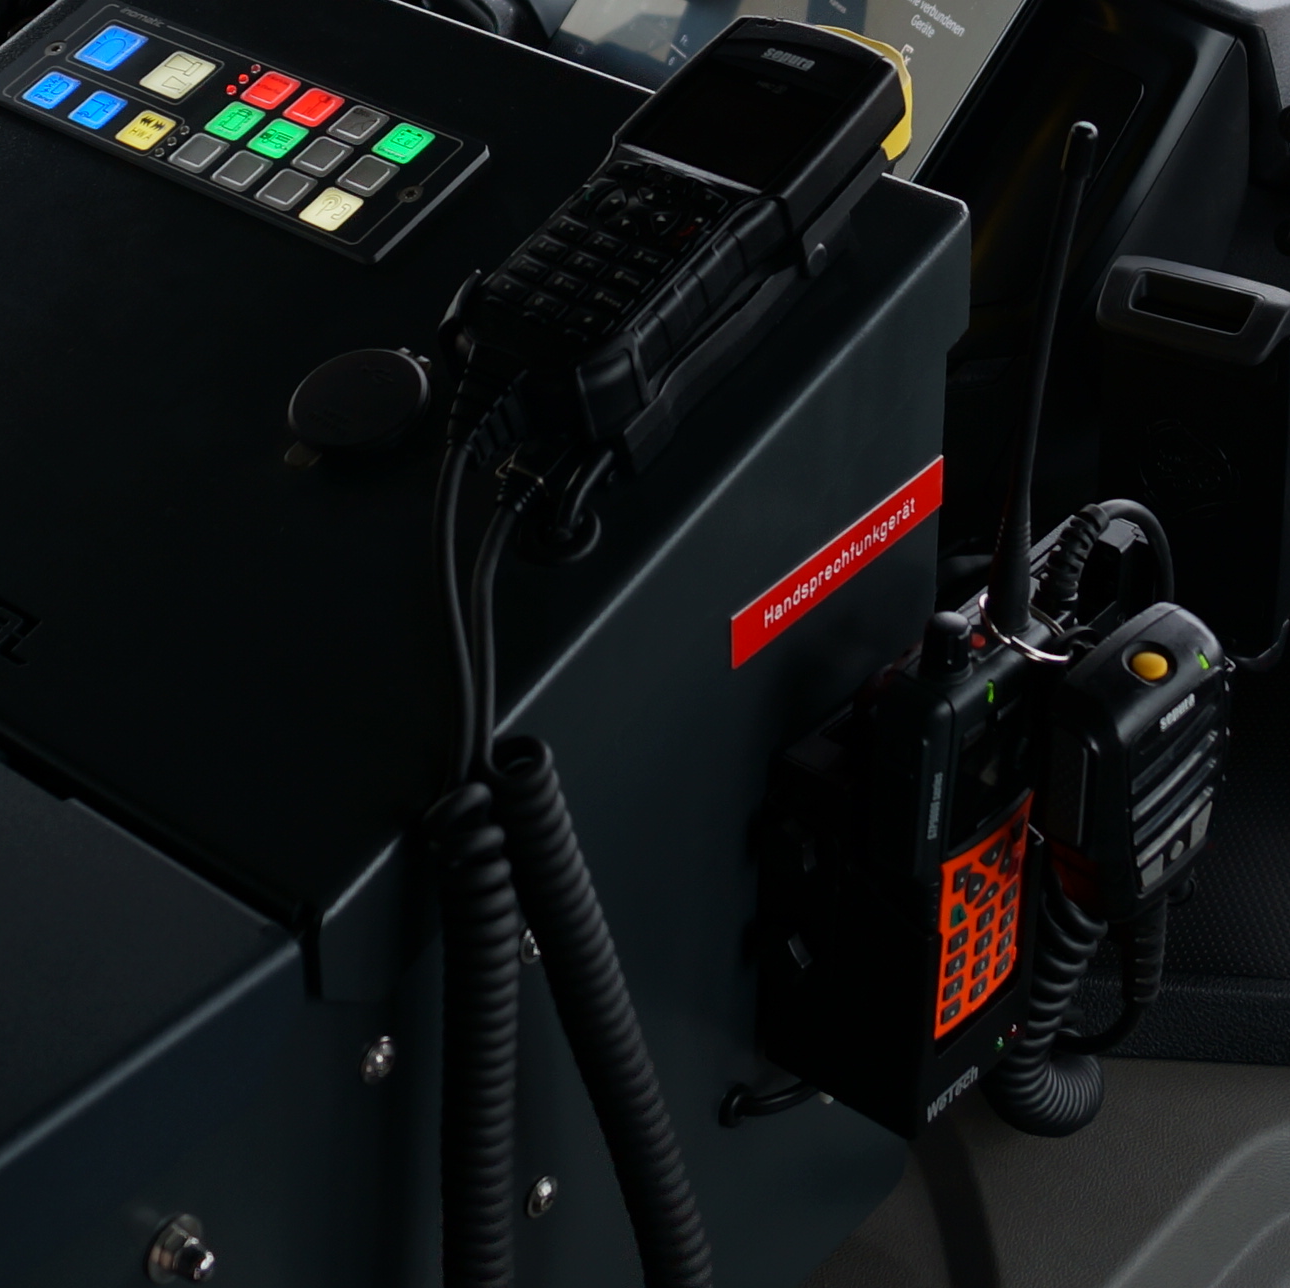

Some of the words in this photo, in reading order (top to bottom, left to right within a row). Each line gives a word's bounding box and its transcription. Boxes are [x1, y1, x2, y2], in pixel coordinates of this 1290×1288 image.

[910, 14, 936, 38] Geräte
[919, 0, 966, 38] verbundenen
[760, 47, 817, 72] sepura
[763, 497, 916, 629] Handsprechfunkgerät
[1159, 692, 1196, 732] sepura
